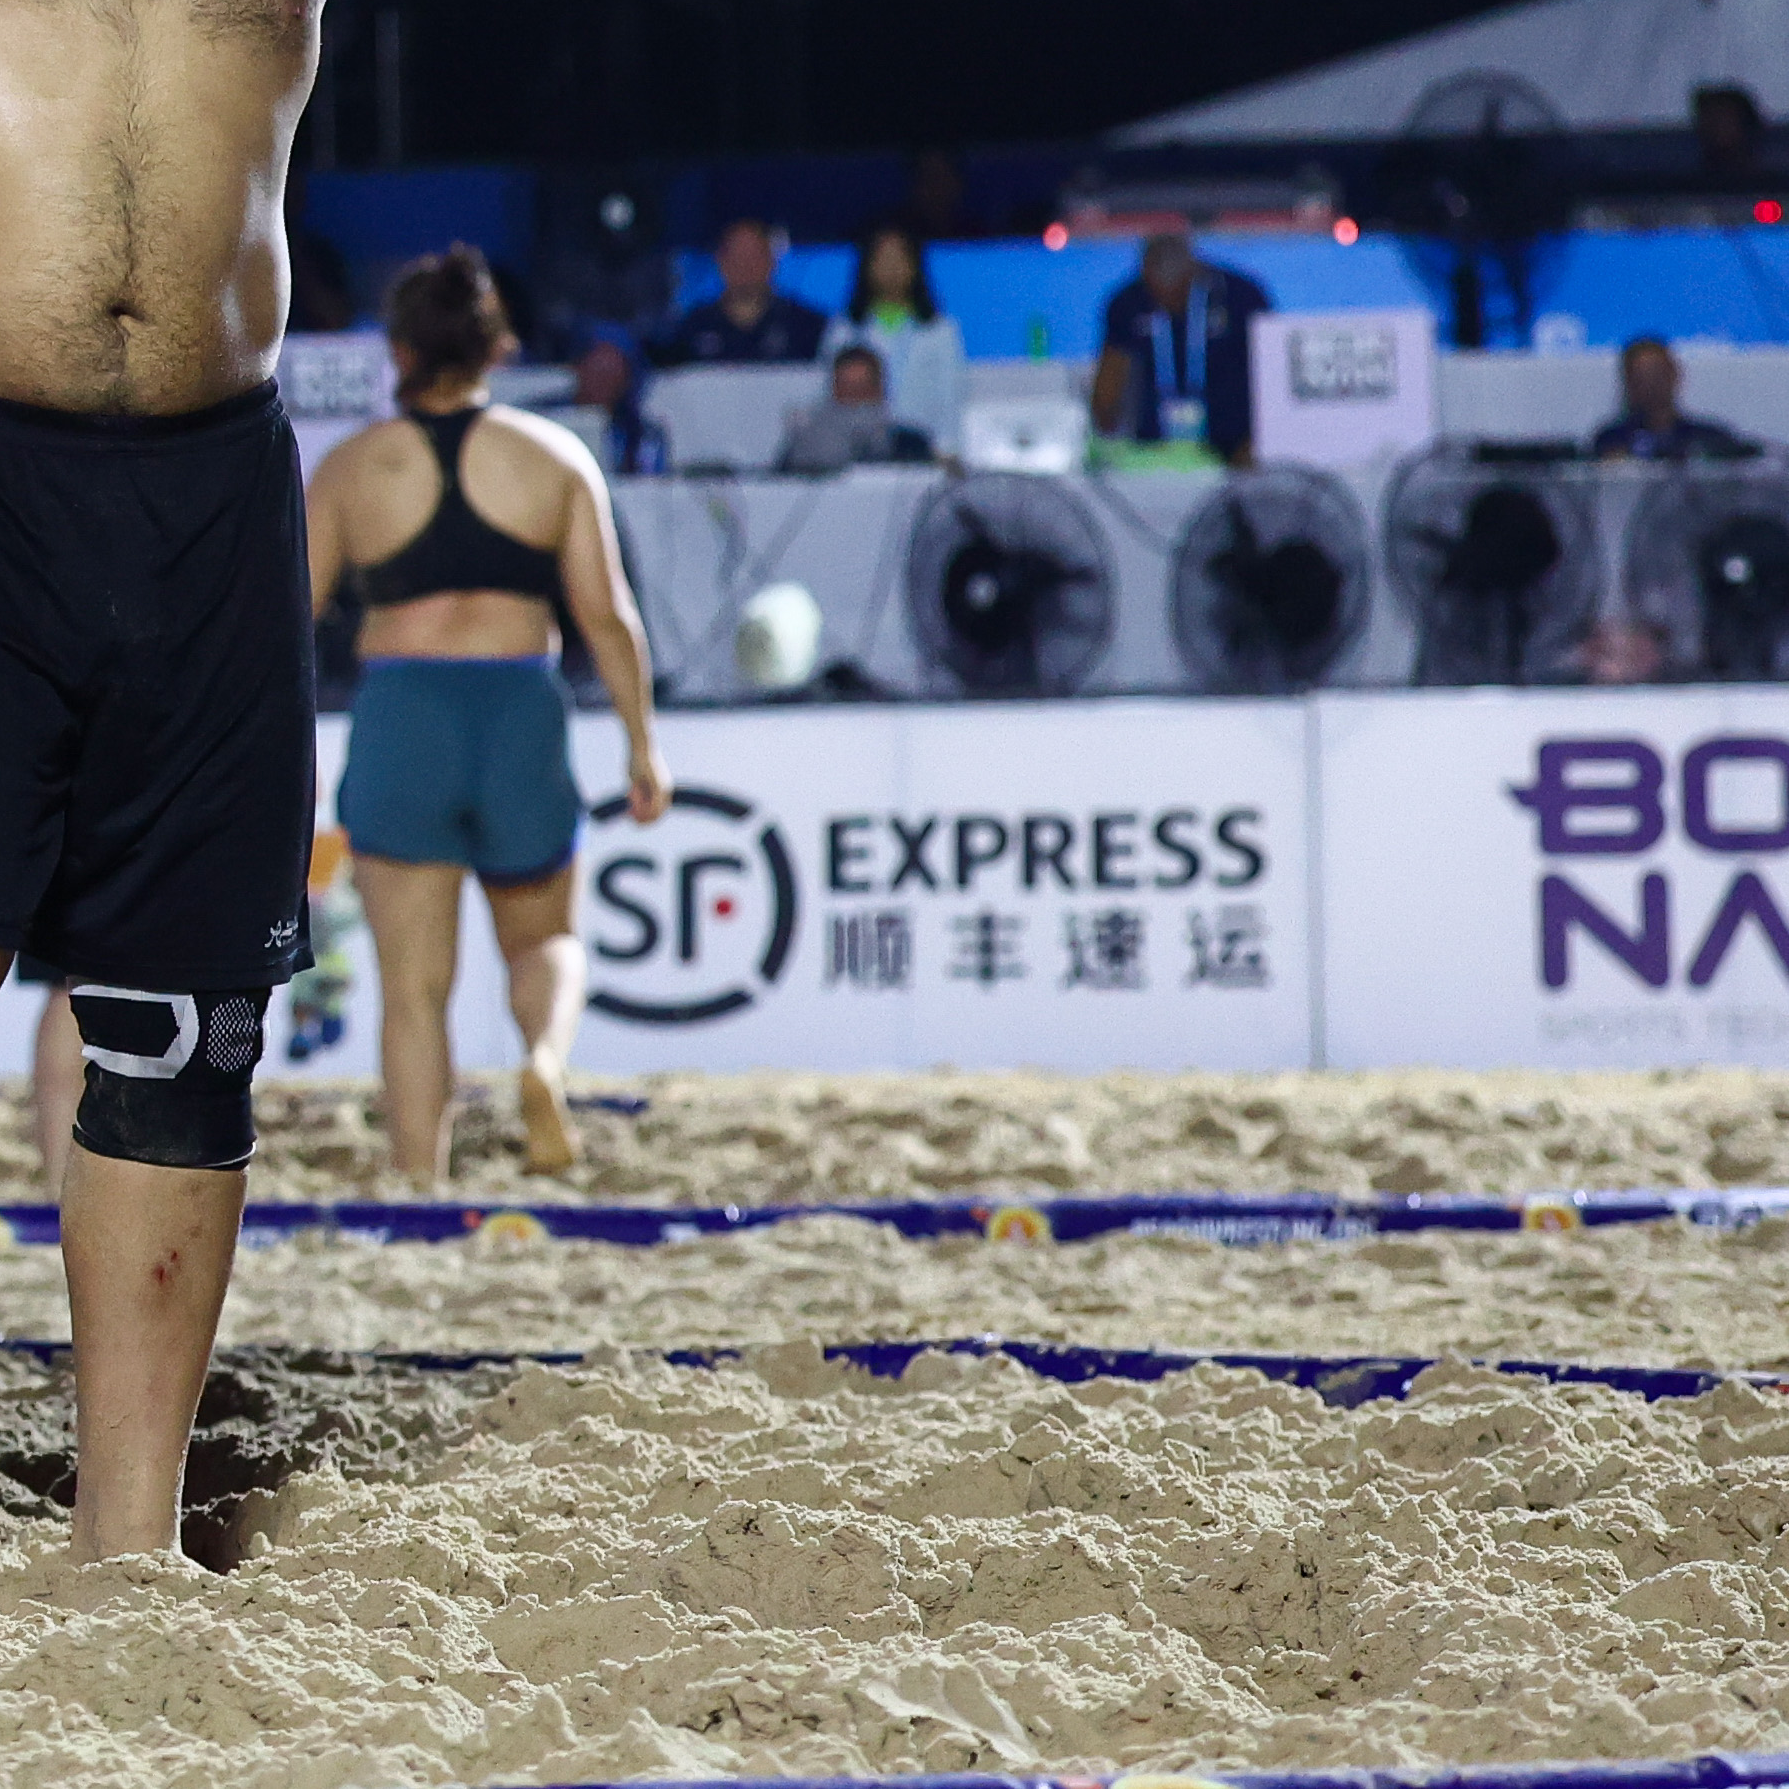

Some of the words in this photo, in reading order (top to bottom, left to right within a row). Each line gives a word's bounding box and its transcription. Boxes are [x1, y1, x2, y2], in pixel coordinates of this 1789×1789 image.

[826, 811, 1268, 893] EXPRESS
[594, 853, 748, 963] SF
[826, 905, 1270, 992] 顺丰速运
